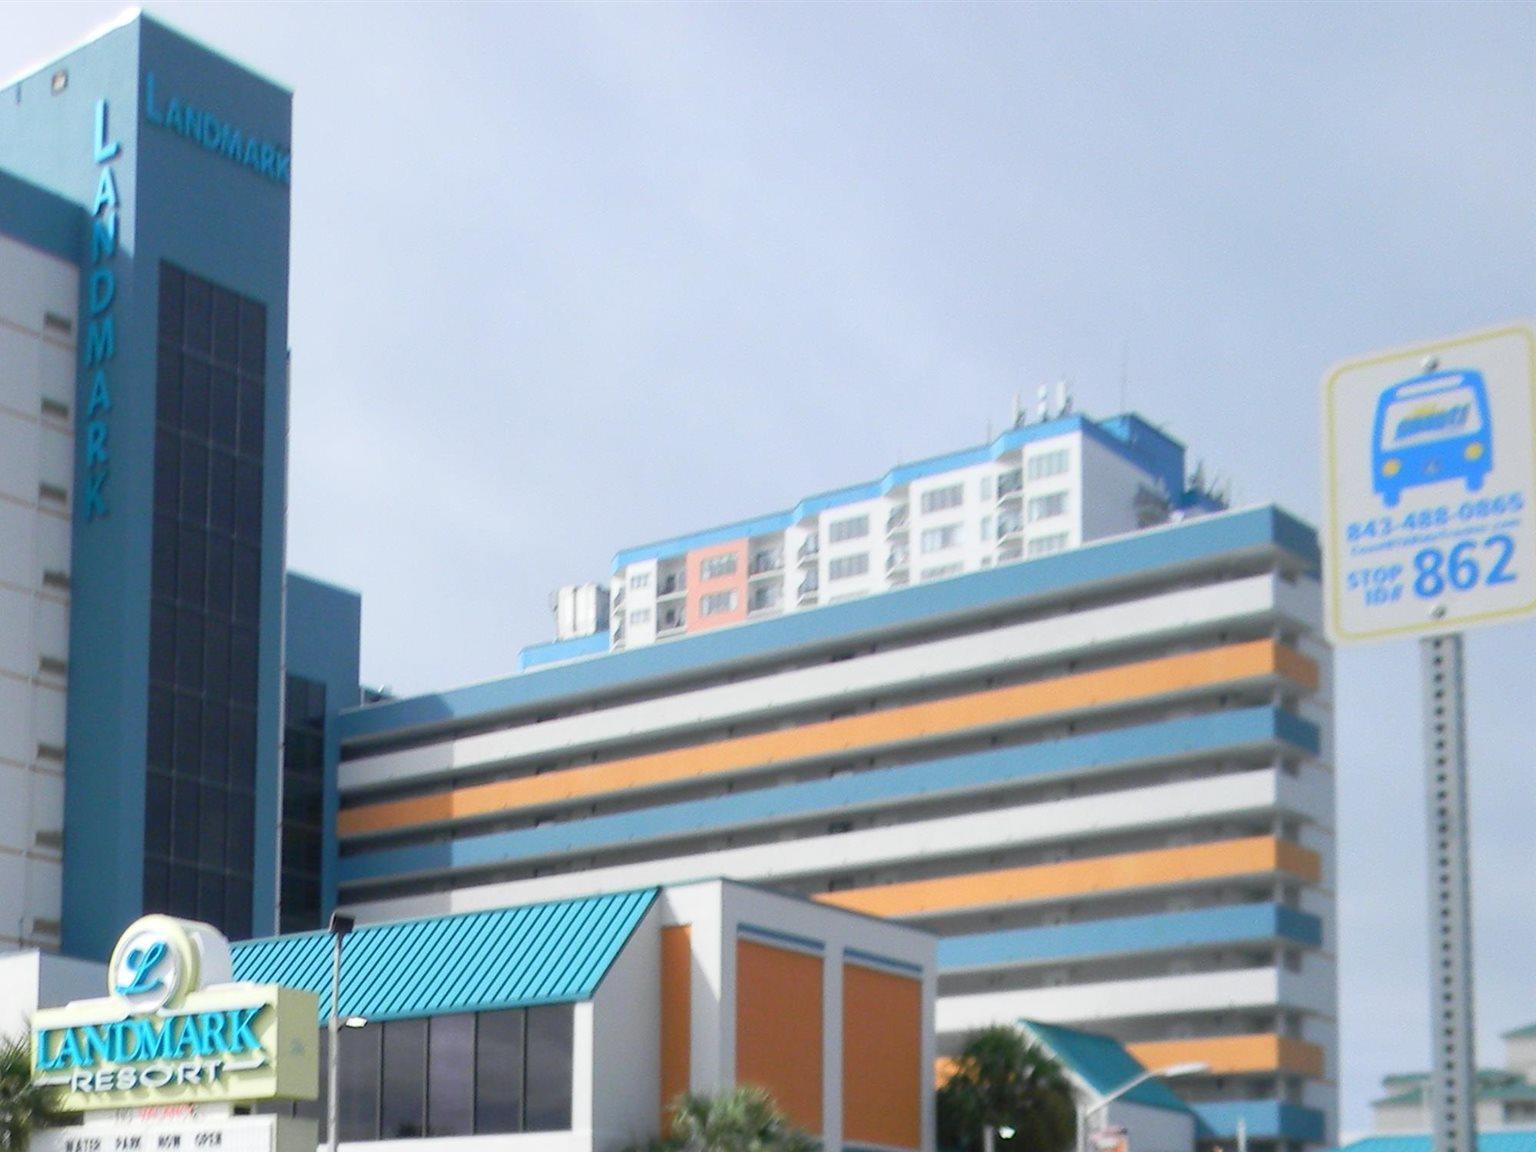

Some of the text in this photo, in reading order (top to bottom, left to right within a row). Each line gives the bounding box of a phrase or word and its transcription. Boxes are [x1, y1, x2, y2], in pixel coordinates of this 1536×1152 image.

[147, 71, 290, 185] LANDMARK
[86, 98, 120, 521] LANDMARK
[1347, 563, 1403, 590] STOP
[1414, 533, 1517, 599] 862
[36, 1006, 264, 1070] LANDMARK
[71, 1060, 223, 1093] RESORT
